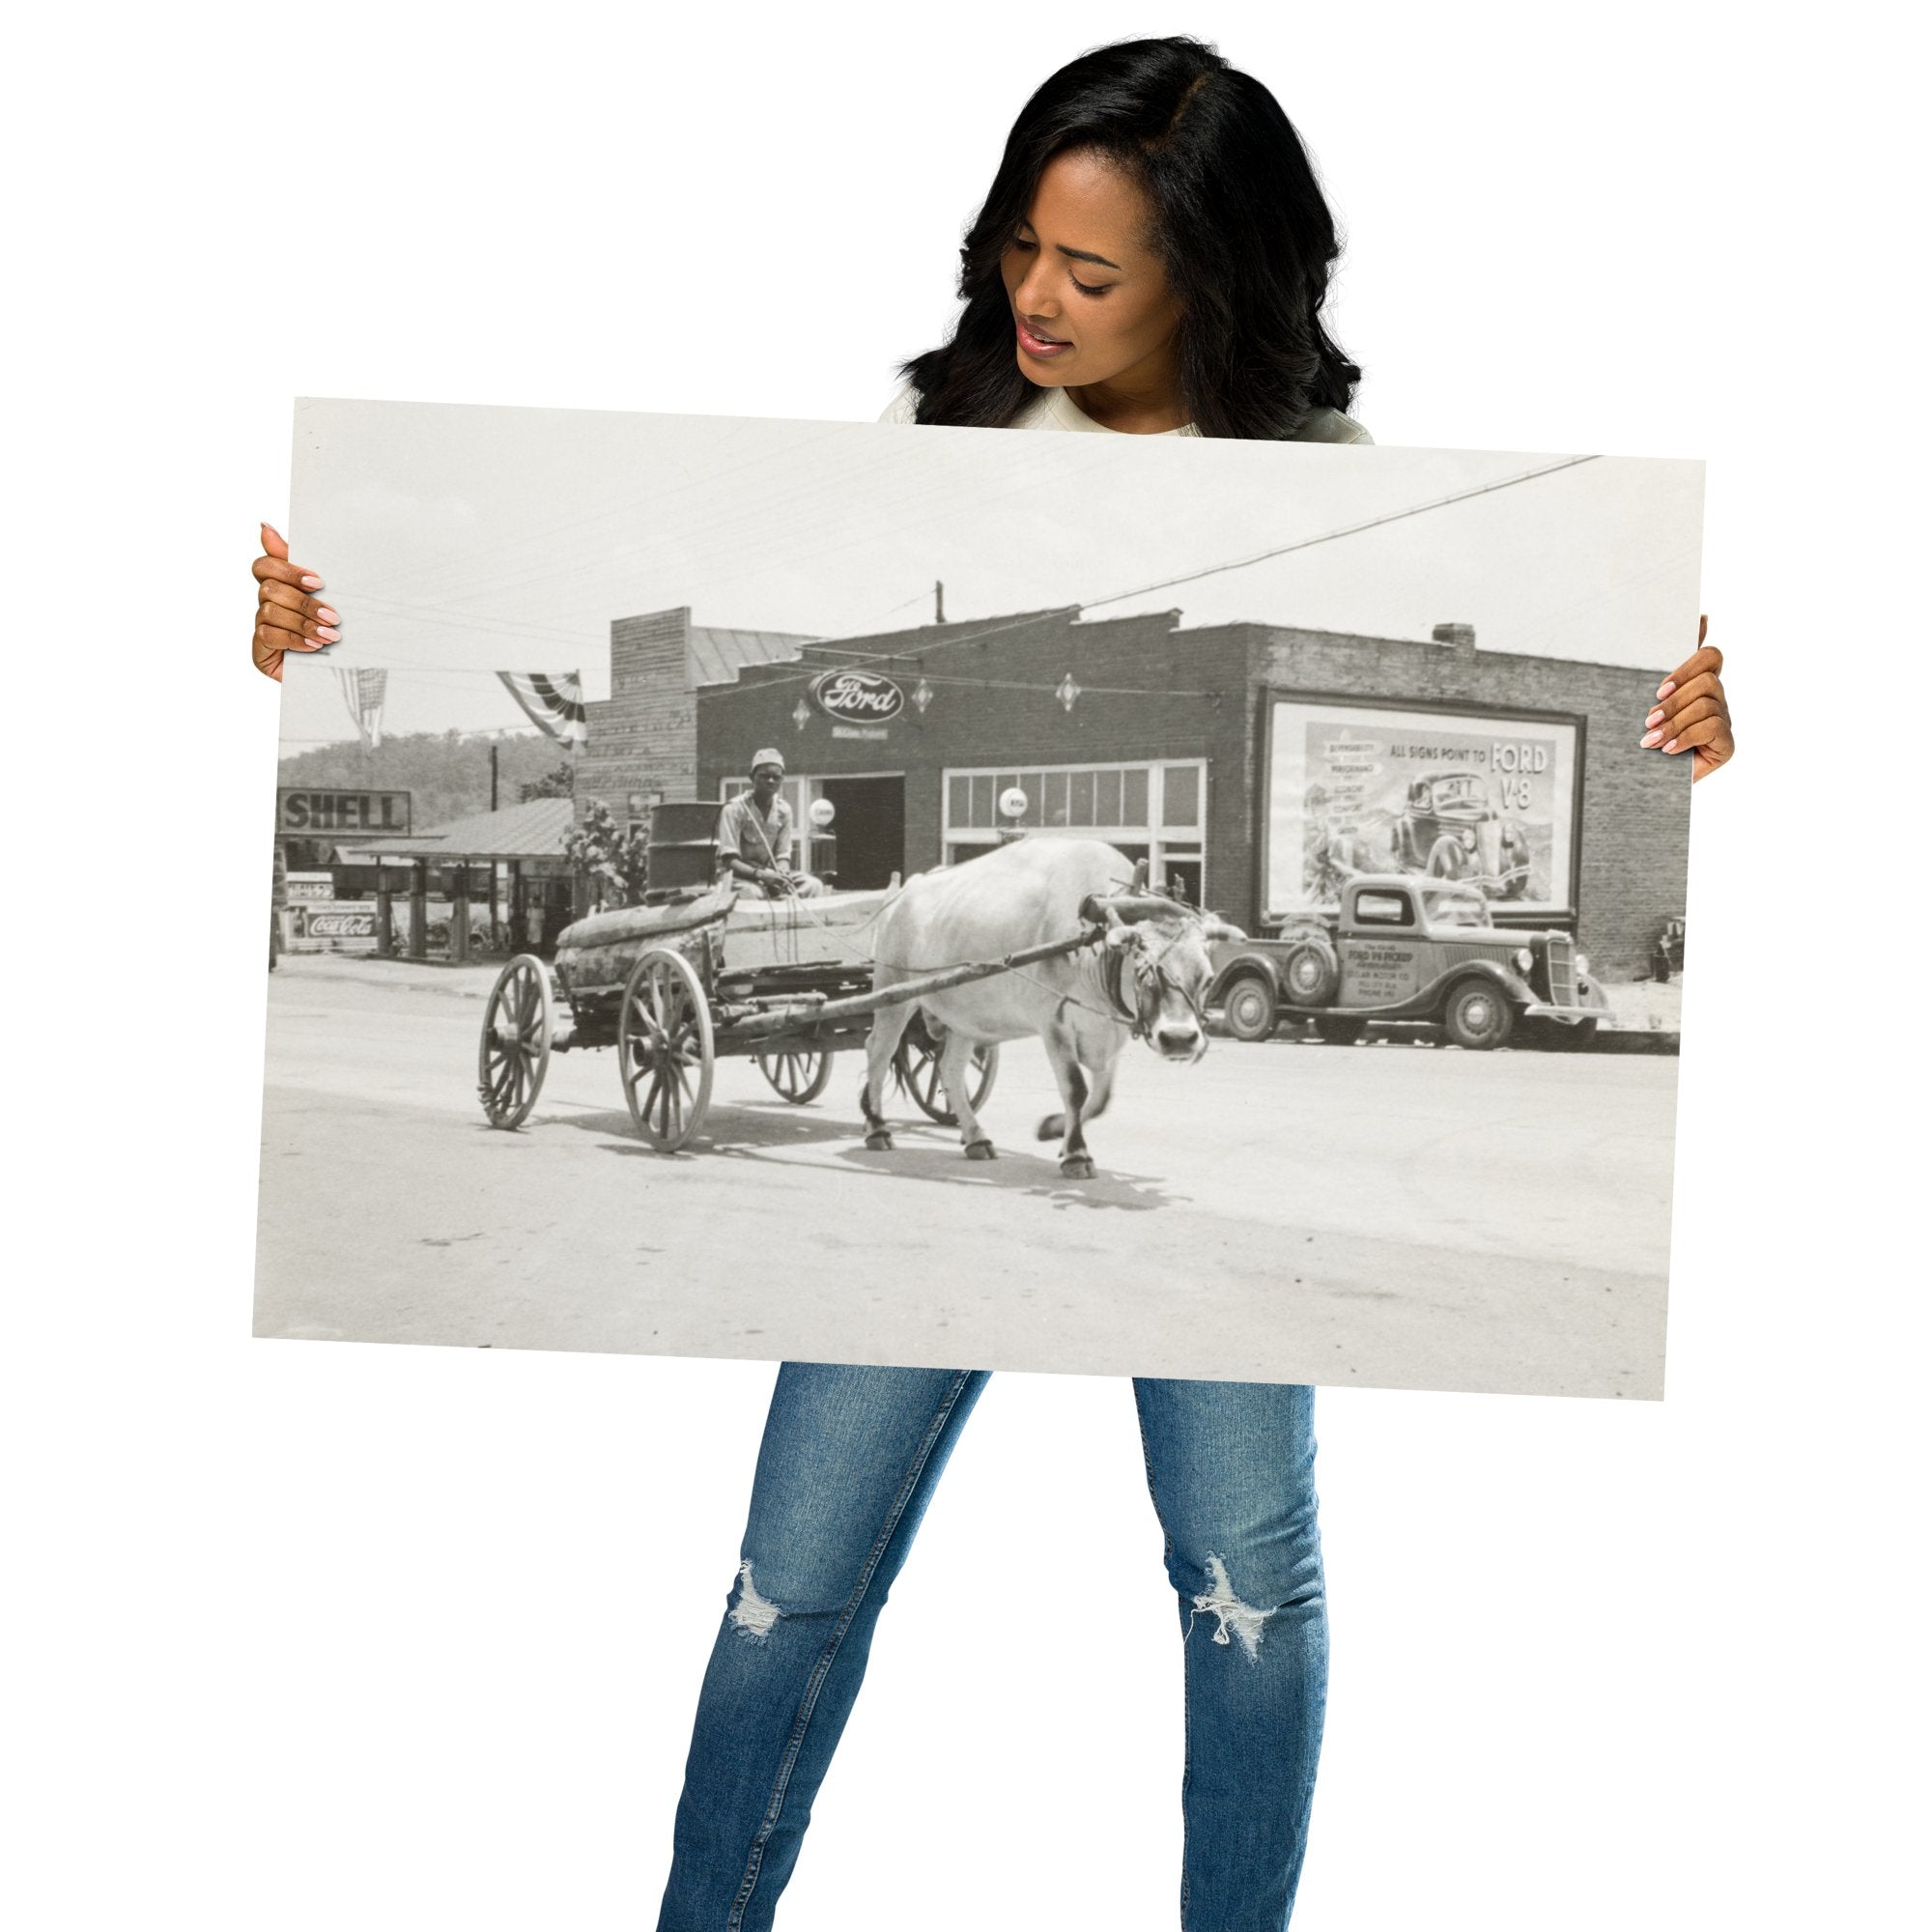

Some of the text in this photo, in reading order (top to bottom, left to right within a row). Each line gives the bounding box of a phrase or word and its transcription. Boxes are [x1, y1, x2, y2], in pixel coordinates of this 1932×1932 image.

[824, 675, 897, 712] Ford
[1390, 742, 1548, 774] ALL SIGNS POINT TO FORD
[284, 792, 405, 831] SHELL
